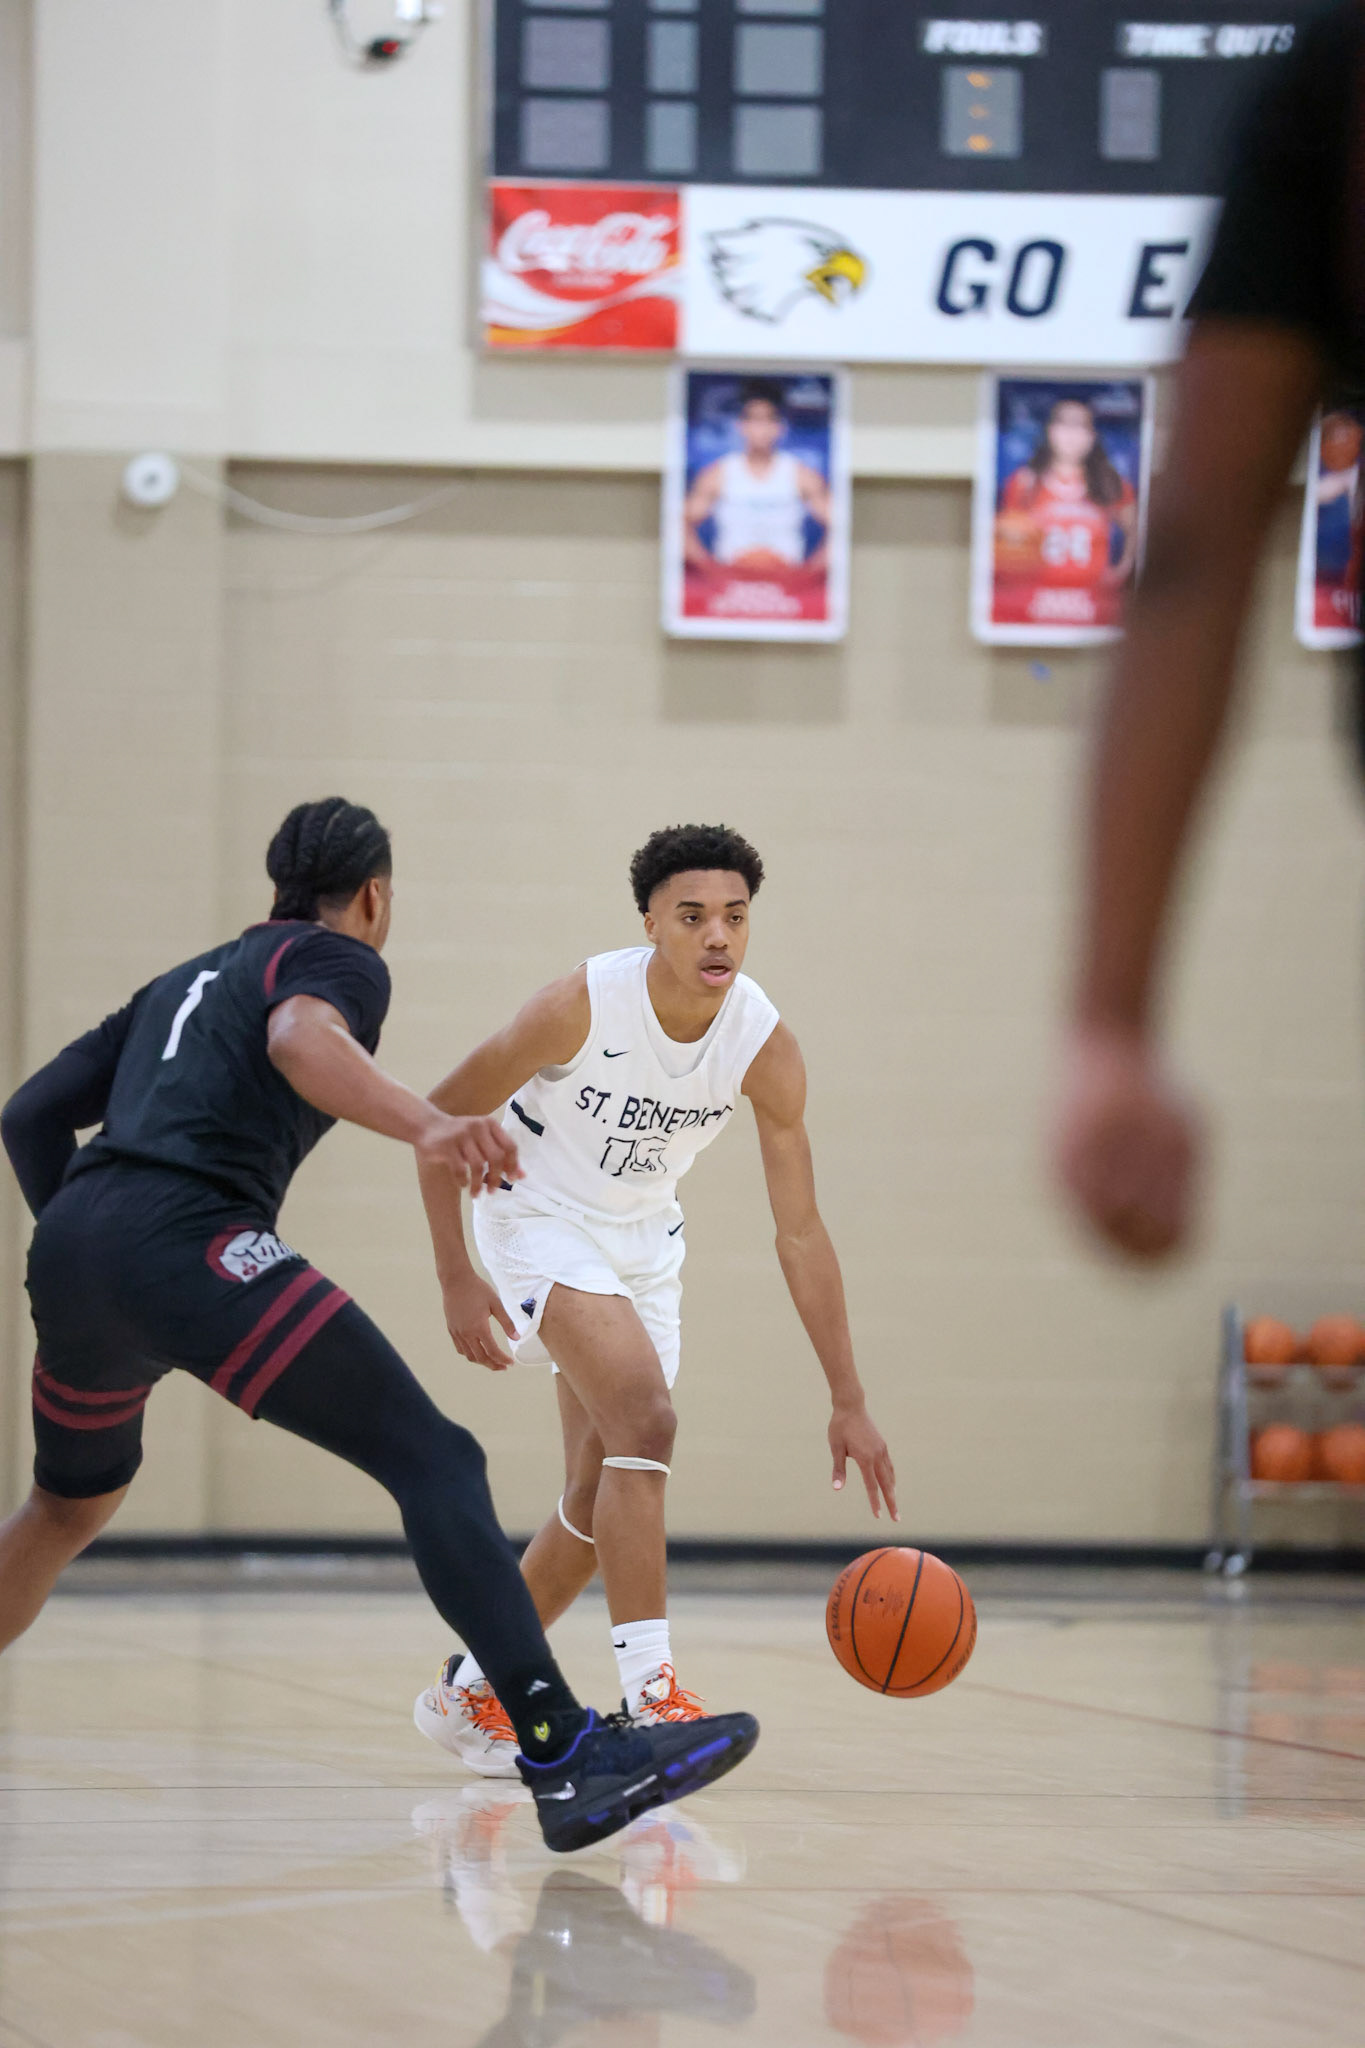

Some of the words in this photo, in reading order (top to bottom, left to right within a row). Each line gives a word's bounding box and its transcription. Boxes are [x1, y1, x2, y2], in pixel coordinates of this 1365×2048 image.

[923, 19, 1042, 55] FOULS
[1124, 22, 1212, 58] TIME
[1214, 23, 1296, 58] OUTS
[497, 209, 676, 275] Coca-Cola
[936, 238, 1066, 318] GO
[161, 970, 220, 1061] 1
[575, 1085, 612, 1124] ST.
